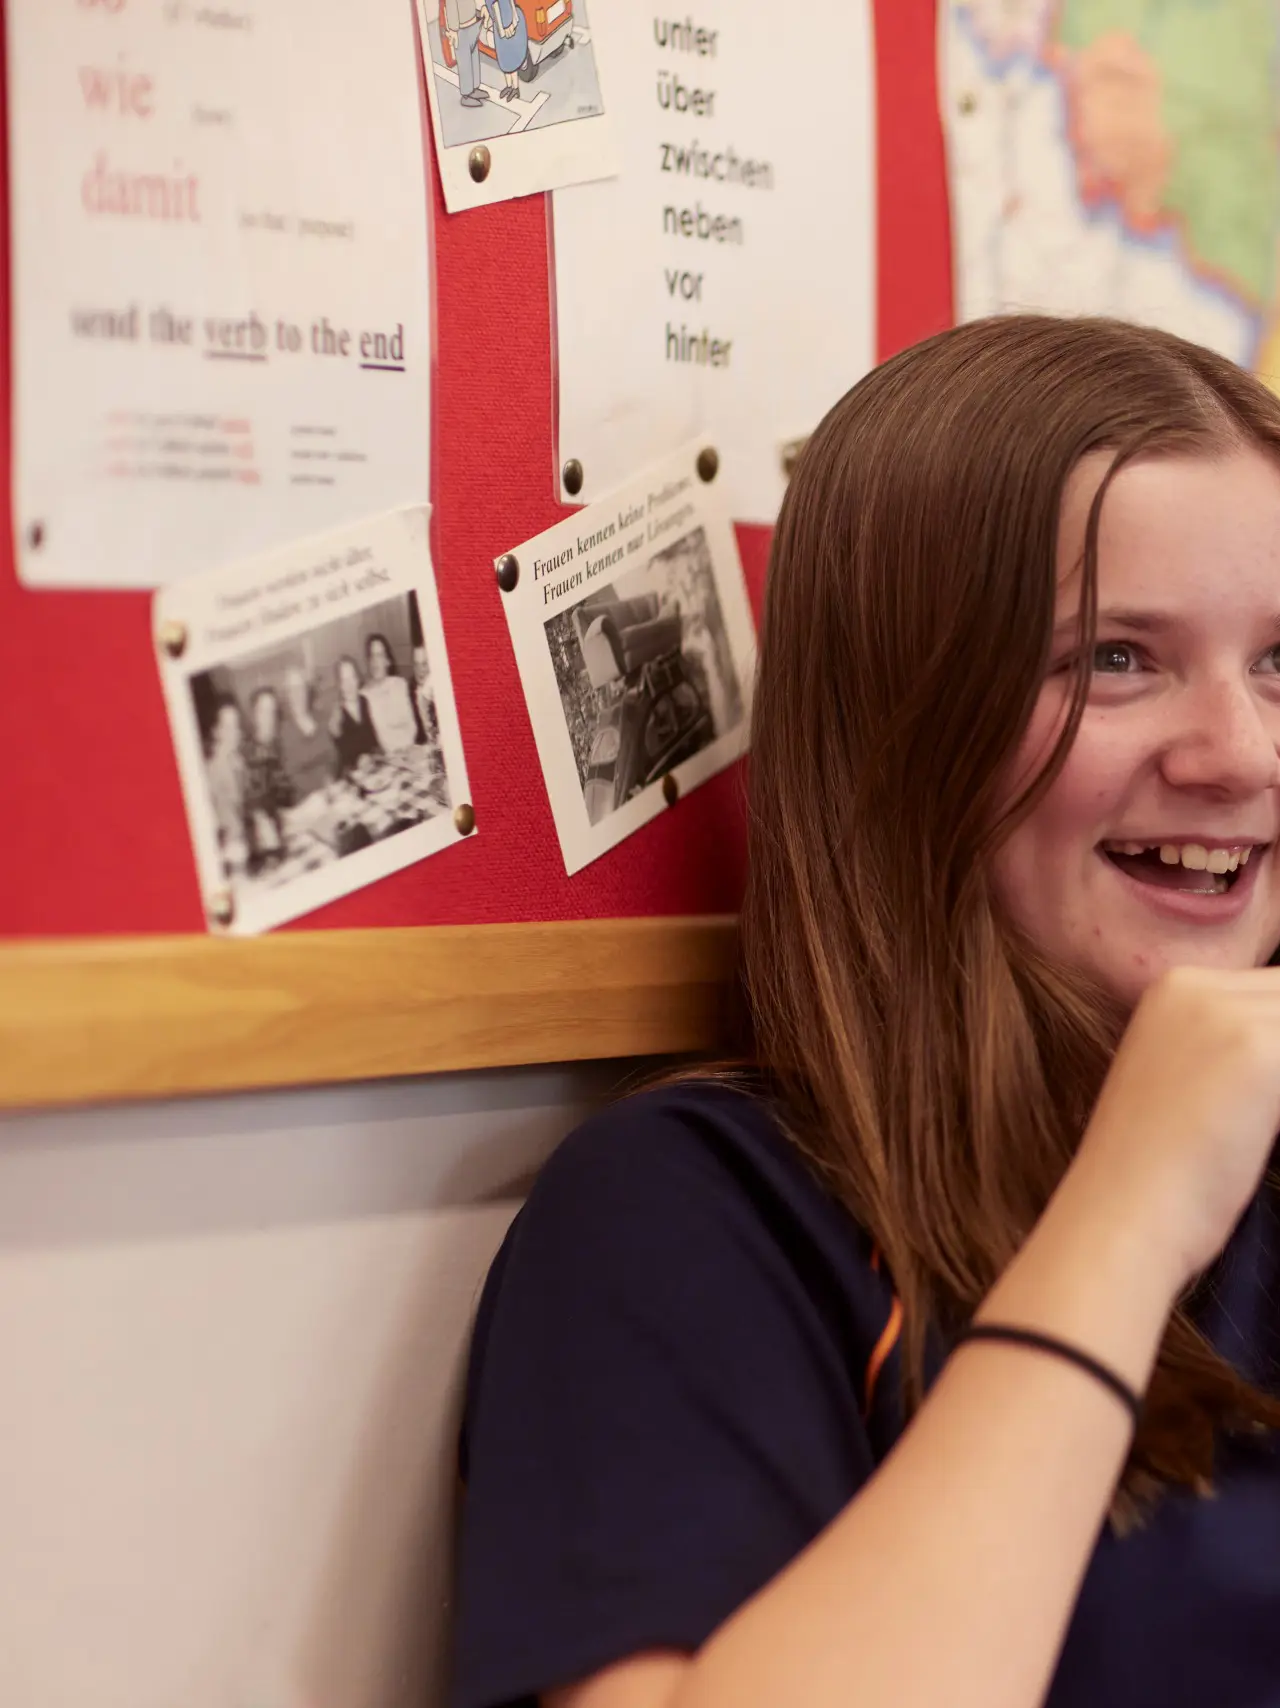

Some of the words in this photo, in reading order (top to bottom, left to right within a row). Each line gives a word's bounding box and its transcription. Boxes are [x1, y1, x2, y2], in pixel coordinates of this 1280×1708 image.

[653, 15, 718, 60] unter
[77, 51, 155, 119] wie
[656, 69, 716, 118] über
[81, 149, 201, 222] damit
[660, 138, 775, 190] zwischen
[663, 200, 744, 245] neben
[664, 267, 703, 303] vor
[203, 310, 267, 351] verb
[275, 316, 302, 352] to
[311, 317, 351, 357] the
[359, 322, 404, 361] end
[665, 320, 732, 367] hinter
[533, 547, 574, 581] Frauen
[576, 522, 616, 556] kennen
[543, 571, 583, 605] Frauen
[586, 546, 624, 580] kennen
